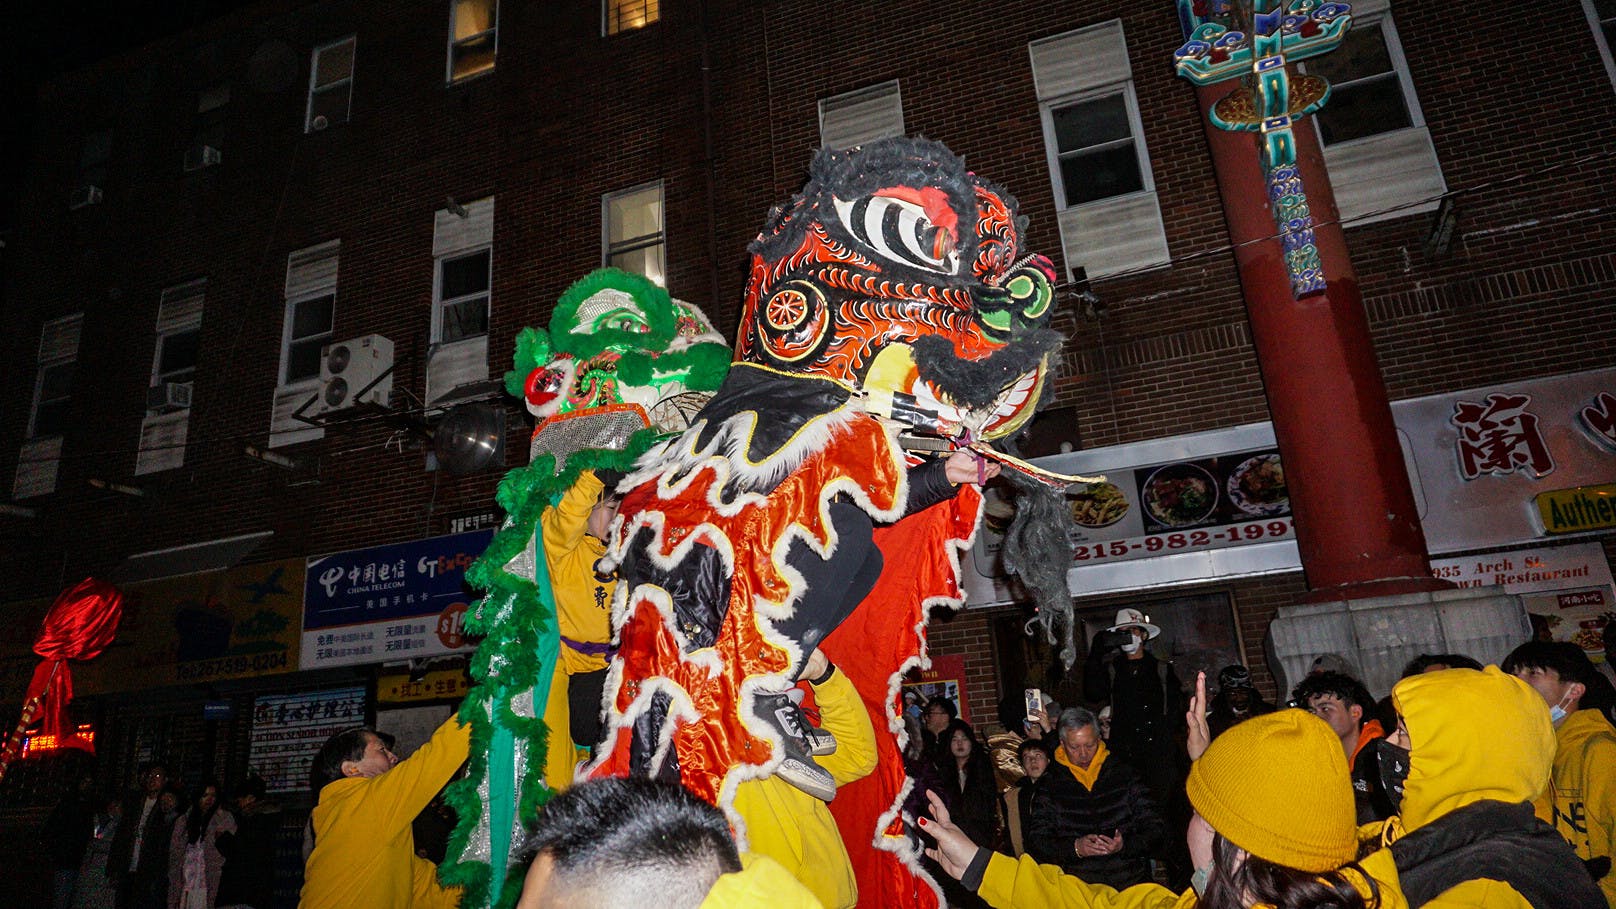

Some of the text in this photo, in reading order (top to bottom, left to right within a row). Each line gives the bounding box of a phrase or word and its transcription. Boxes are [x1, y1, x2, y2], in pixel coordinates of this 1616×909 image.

[1073, 521, 1294, 561] 215-982-199
[347, 557, 407, 586] 中国电信
[1432, 556, 1546, 579] 935 Arch St.
[1494, 564, 1590, 586] Restaurant
[347, 580, 406, 595] CHINA TELECOM
[366, 592, 428, 609] 美国手机卡
